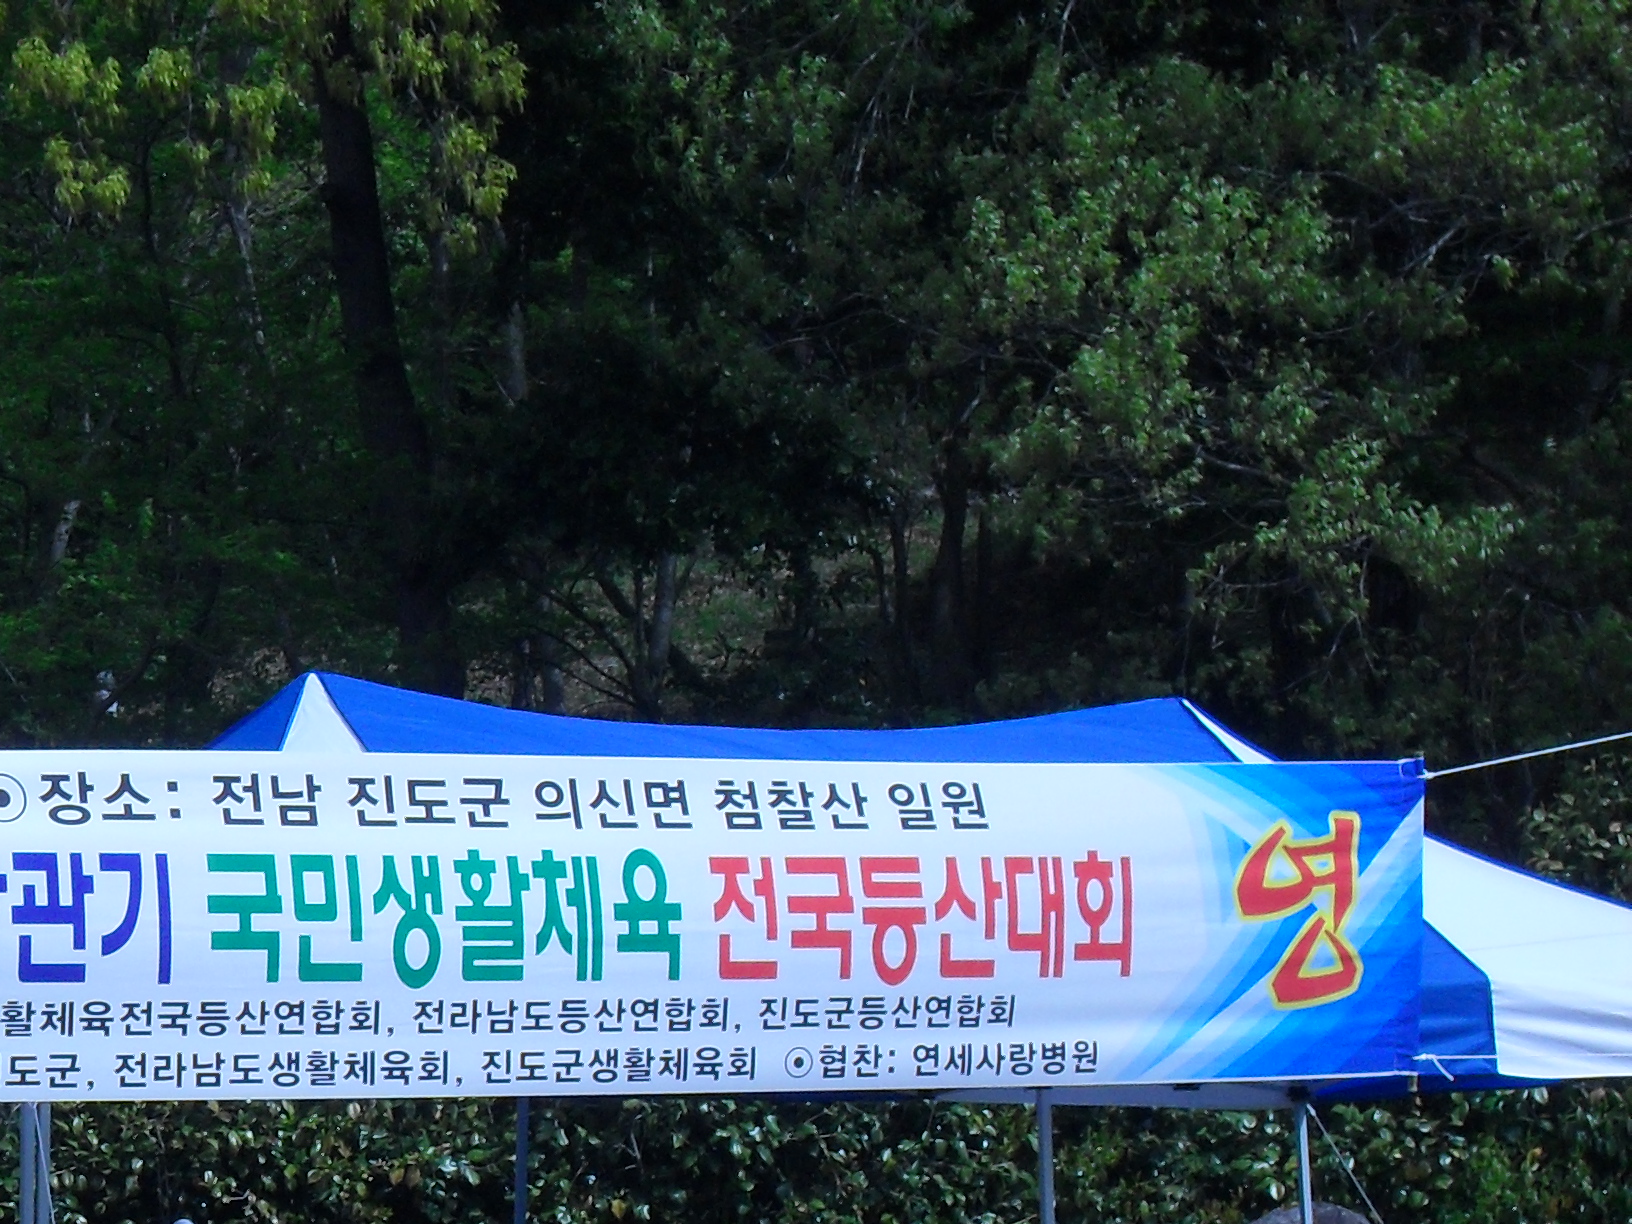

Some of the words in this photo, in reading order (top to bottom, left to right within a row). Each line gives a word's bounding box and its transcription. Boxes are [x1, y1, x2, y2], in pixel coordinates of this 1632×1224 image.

[37, 770, 182, 826] 장소:
[211, 772, 322, 828] 전남
[346, 774, 511, 829] 진도군
[534, 777, 694, 831] 의신면
[713, 779, 871, 831] 첨찰산
[887, 781, 990, 831] 일원
[205, 847, 684, 990] 국민생활체육
[708, 849, 1133, 987] 전국등산대회
[1234, 810, 1364, 1012] 영
[411, 996, 742, 1036] 전라남도등산연합회,
[758, 994, 1016, 1031] 진도군등산연합회
[113, 1049, 464, 1089] 전라남도생활체육회,
[480, 1045, 757, 1085] 진도군생활체육회
[818, 1043, 897, 1080] 협찬:
[912, 1040, 1098, 1078] 연세사랑병원
